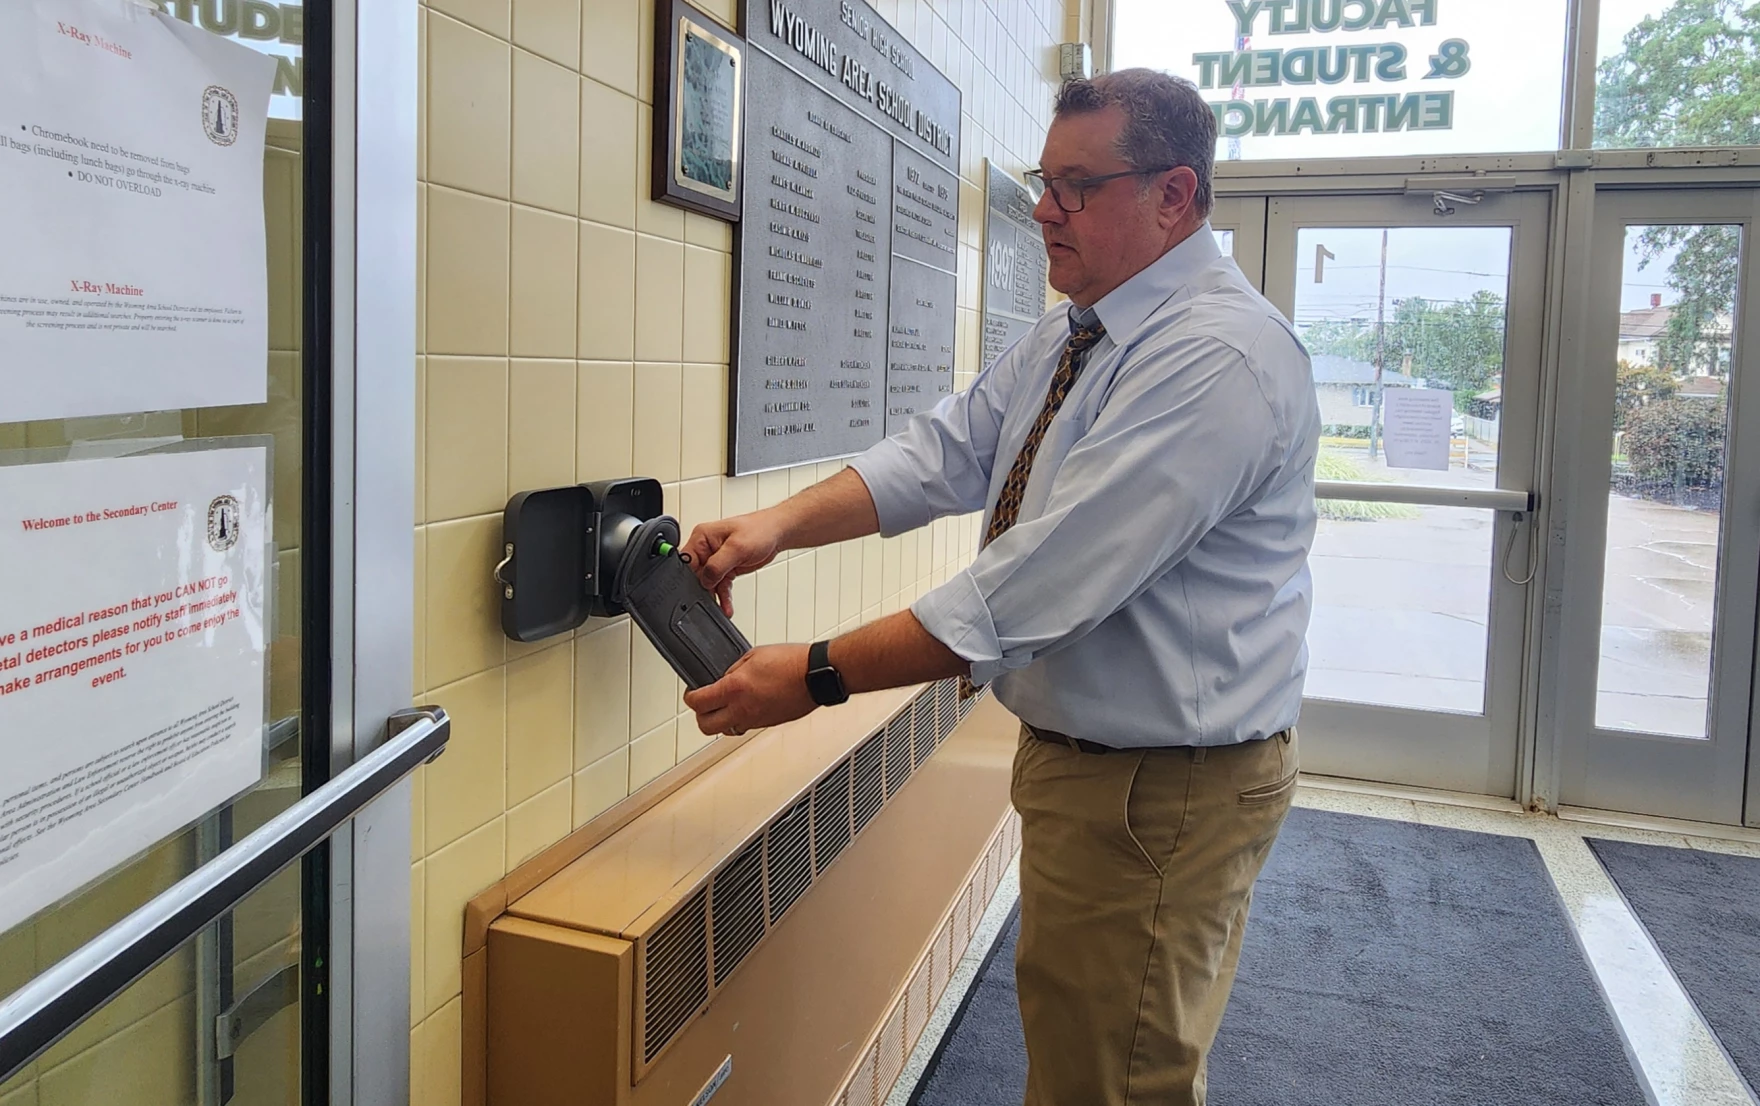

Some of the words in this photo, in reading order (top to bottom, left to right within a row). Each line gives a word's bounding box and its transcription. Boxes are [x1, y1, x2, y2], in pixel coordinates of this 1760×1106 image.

[57, 21, 91, 46] X-Ray
[94, 35, 132, 60] Machine
[840, 1, 868, 40] SENIOR
[871, 27, 889, 58] HIGH
[890, 45, 915, 81] SCHOOL
[769, 0, 837, 77] WYOMING
[840, 54, 873, 103] AREA
[877, 81, 914, 132] SCHOOL
[916, 110, 954, 157] DISTRICT
[10, 138, 31, 154] bags
[34, 144, 79, 166] (including
[81, 154, 104, 169] lunch
[105, 160, 124, 175] bags)
[126, 167, 135, 177] go
[136, 168, 162, 184] through
[163, 174, 173, 184] the
[191, 183, 216, 195] machine
[31, 125, 89, 148] Chromebook
[91, 141, 109, 153] need
[110, 145, 118, 155] to
[120, 146, 128, 158] be
[130, 152, 158, 166] removed
[160, 158, 176, 170] from
[77, 170, 93, 183] DO
[94, 174, 114, 188] NOT
[116, 178, 162, 198] OVERLOAD
[71, 280, 103, 296] X-Ray
[105, 283, 144, 296] Machine
[989, 238, 1014, 292] 1997
[22, 516, 70, 532] Welcome
[74, 514, 84, 524] to
[86, 511, 101, 522] the
[104, 505, 149, 520] Secondary
[151, 500, 178, 512] Center
[20, 630, 28, 641] a
[32, 612, 84, 638] medical
[88, 603, 128, 622] reason
[131, 595, 152, 611] that
[154, 592, 172, 608] you
[175, 582, 196, 598] CAN
[198, 576, 216, 592] NOT
[218, 576, 228, 588] go
[26, 636, 88, 664] detectors
[92, 624, 130, 647] please
[133, 612, 162, 632] notify
[165, 604, 188, 622] staff
[188, 590, 237, 614] immediately
[34, 648, 122, 684] arrangements
[126, 642, 141, 655] for
[143, 635, 162, 652] you
[164, 631, 174, 642] to
[177, 622, 202, 638] come
[204, 612, 226, 628] enjoy
[226, 608, 240, 620] the
[92, 666, 127, 688] event.
